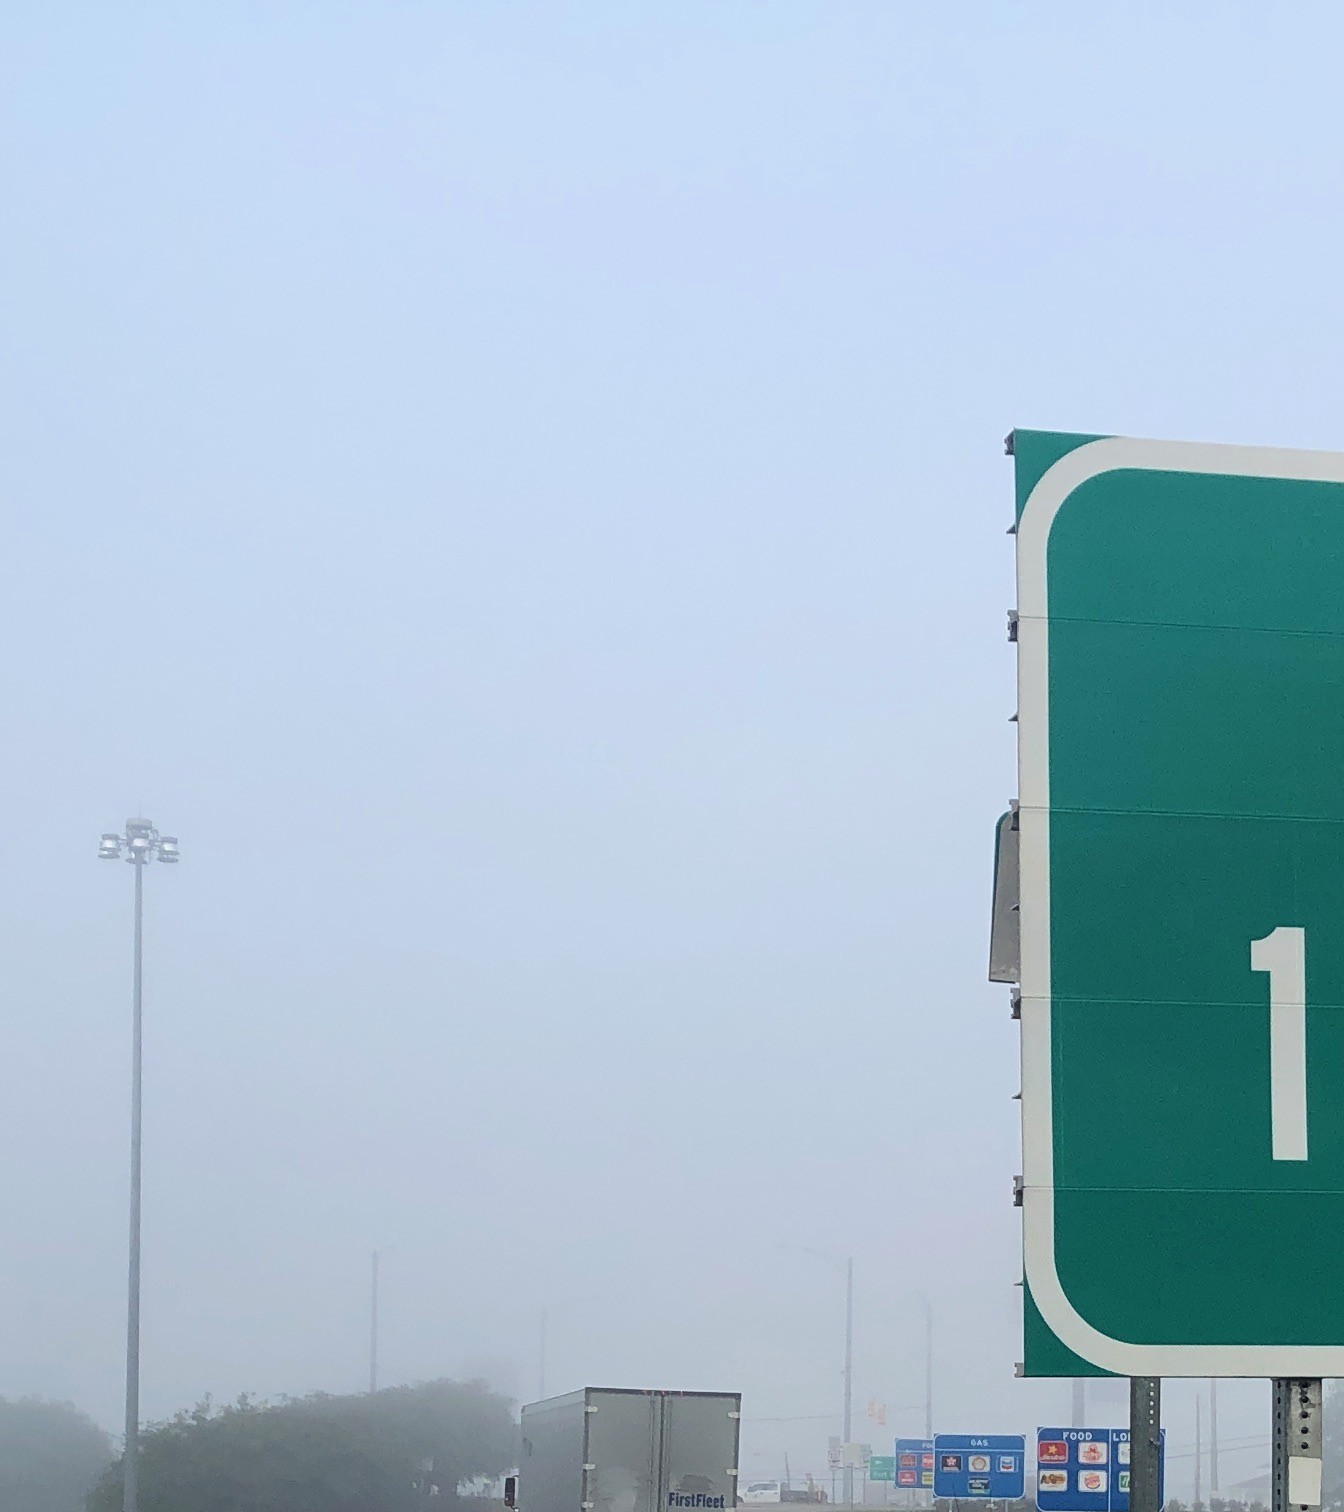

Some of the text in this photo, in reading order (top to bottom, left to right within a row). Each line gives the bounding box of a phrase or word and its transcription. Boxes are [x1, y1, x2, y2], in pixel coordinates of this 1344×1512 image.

[1062, 1431, 1093, 1441] FOOD
[970, 1438, 989, 1447] GAS
[668, 1492, 725, 1509] FirstFleet
